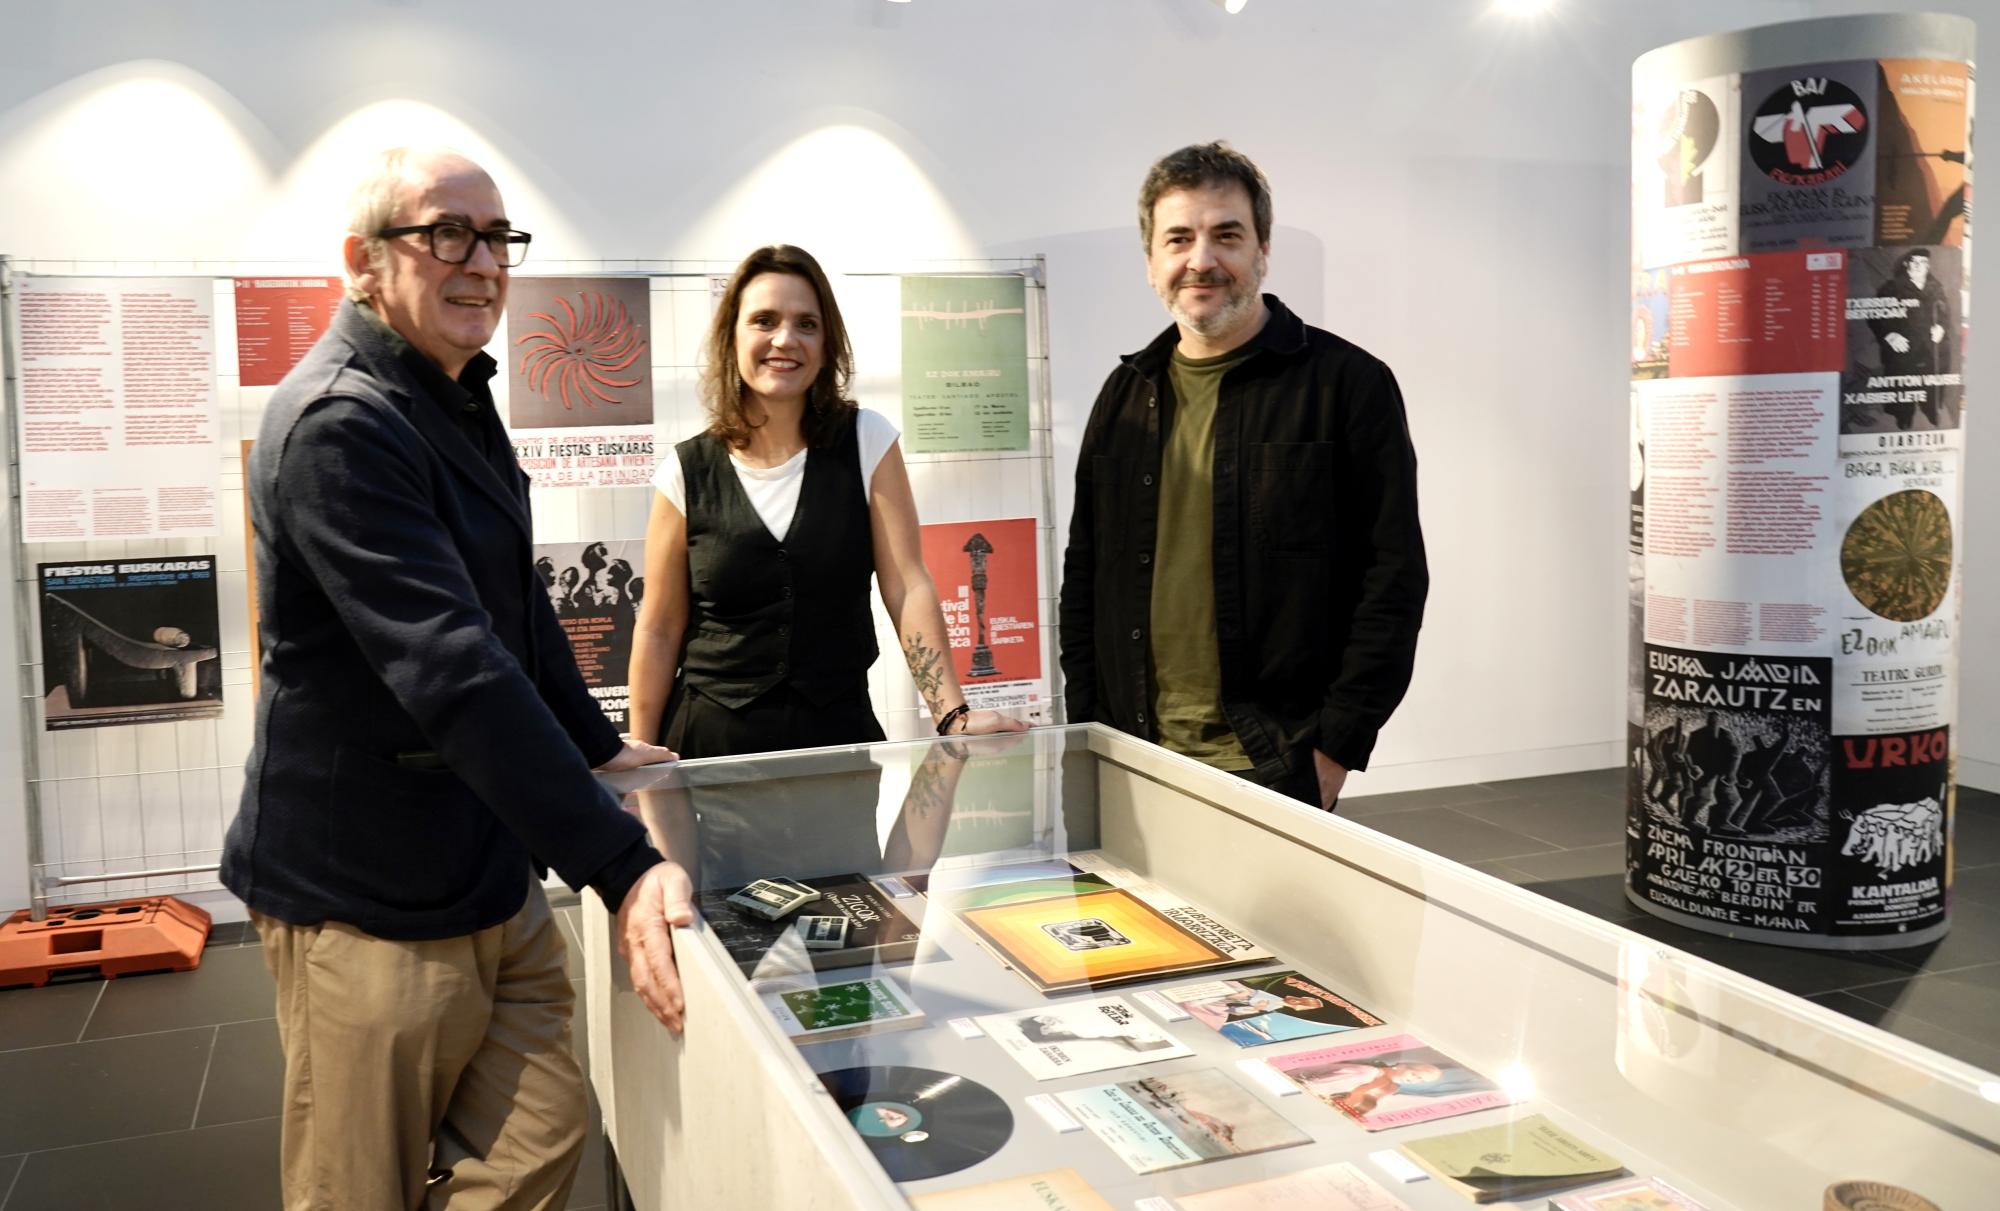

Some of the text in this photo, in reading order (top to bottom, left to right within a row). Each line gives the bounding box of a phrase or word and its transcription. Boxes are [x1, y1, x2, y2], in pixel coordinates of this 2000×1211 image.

[1790, 77, 1828, 97] BAI
[1867, 375, 1922, 388] ANTTON
[1844, 390, 1928, 405] XABIER LETE
[512, 442, 654, 458] XXIV FIESTAS EUSKARAS
[558, 472, 573, 481] DE
[580, 471, 594, 480] LA
[43, 560, 210, 578] FIESTAS EUSKARAS
[957, 612, 970, 624] la
[1841, 628, 1863, 655] EZ
[1867, 636, 1898, 656] DOK
[1649, 651, 1714, 679] EUSKAL
[1862, 668, 1911, 683] TEATRO
[1652, 674, 1822, 711] ZARAUTZ EN
[1843, 730, 1947, 769] URKO
[1647, 824, 1806, 865] ZINEMA FRONTOIAN
[1661, 864, 1721, 889] GAUEKO
[1731, 880, 1751, 893] 10
[1726, 858, 1755, 881] 29
[1786, 866, 1821, 888] 30
